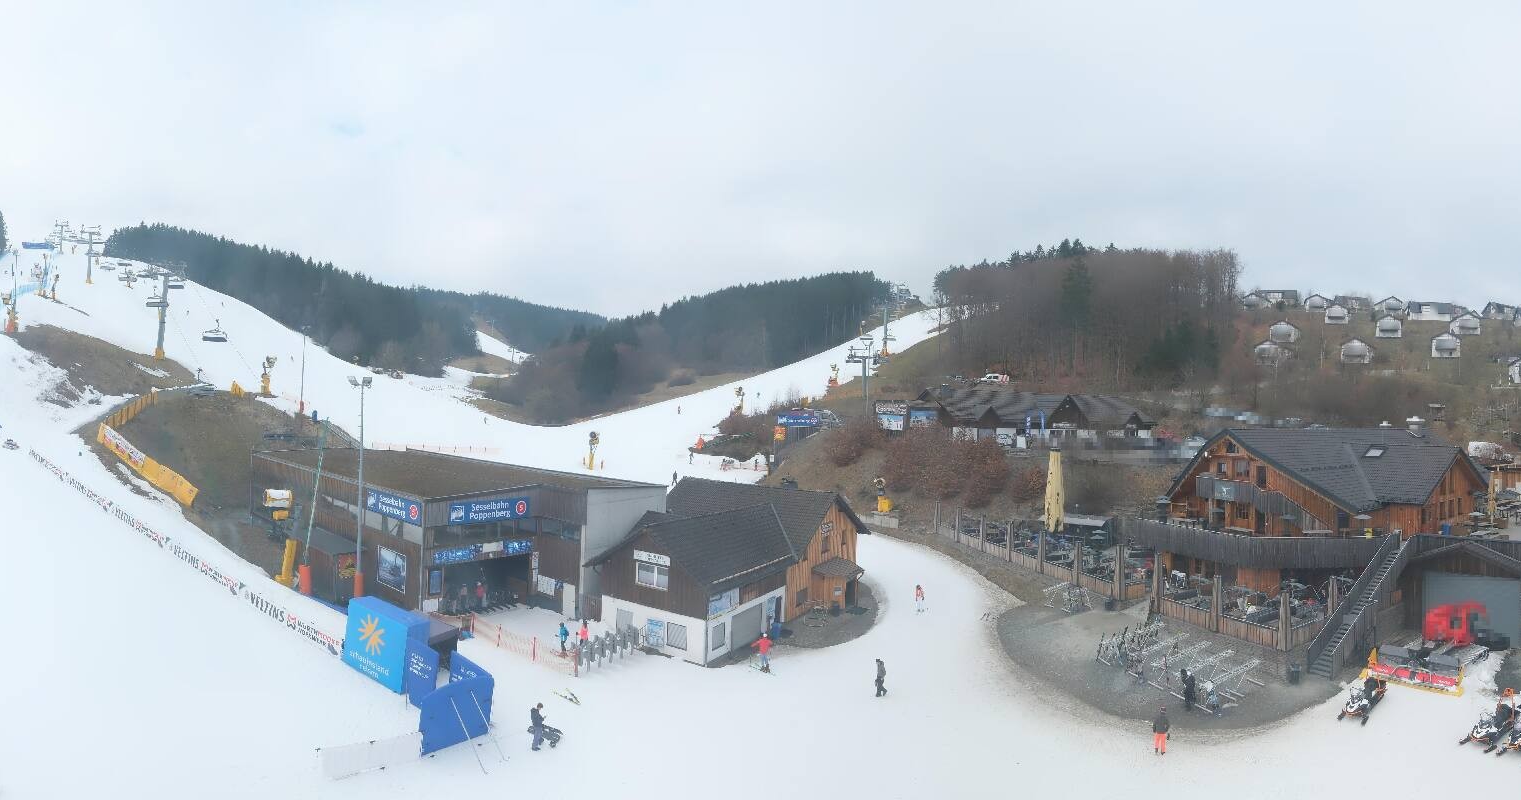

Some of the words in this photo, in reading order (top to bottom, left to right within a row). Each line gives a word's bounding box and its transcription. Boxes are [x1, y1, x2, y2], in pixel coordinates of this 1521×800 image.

[379, 494, 405, 508] Sesselbahn
[471, 501, 509, 511] Sesselbahn
[378, 502, 406, 519] Poppenberg
[469, 509, 511, 521] Poppenberg
[173, 544, 200, 569] VELTINS
[250, 591, 285, 623] VELTINS
